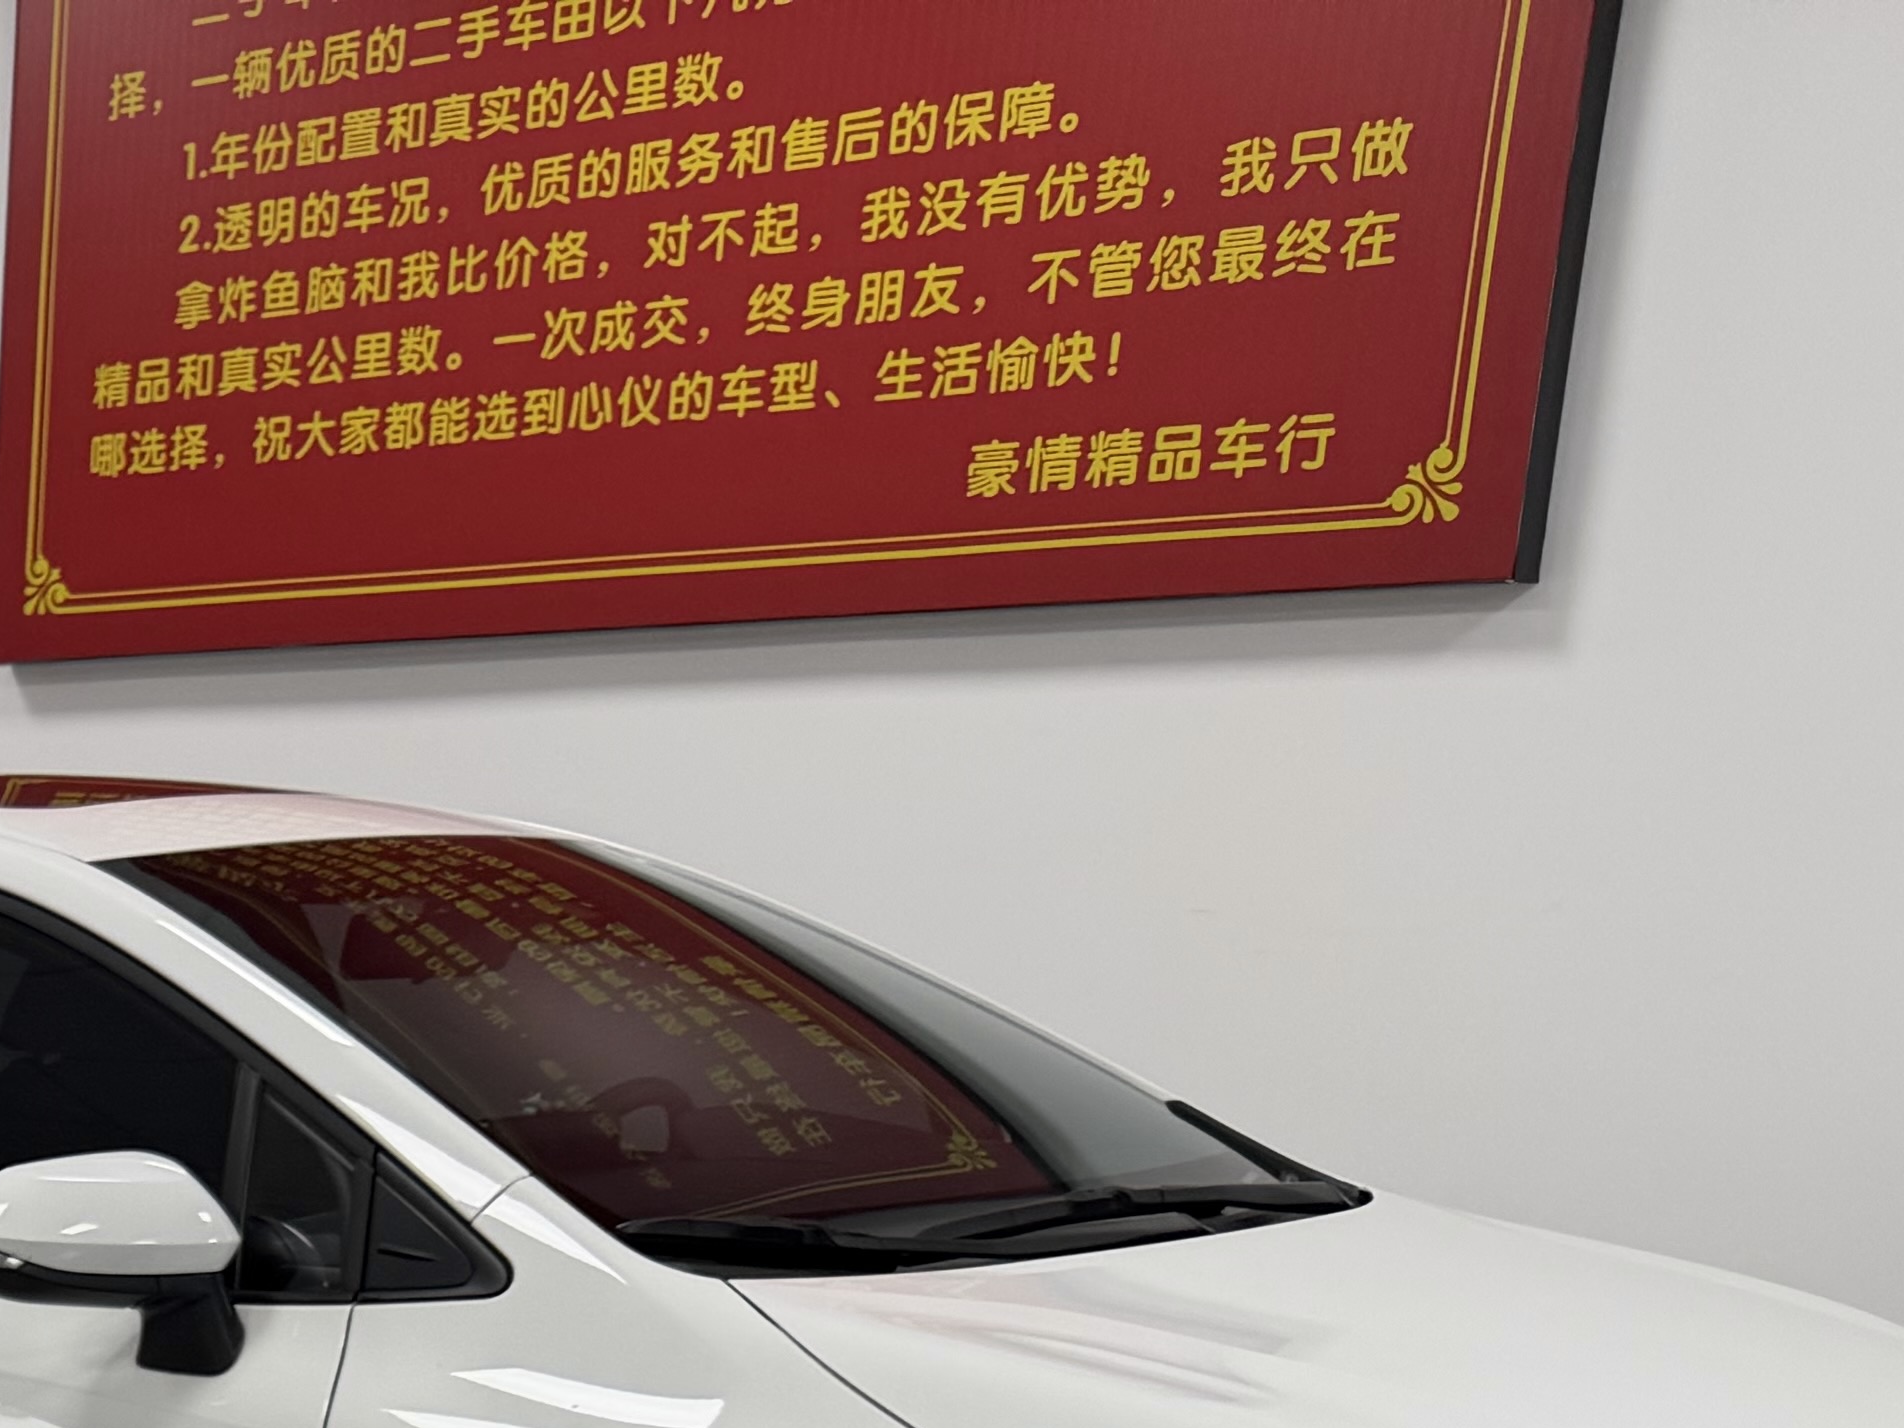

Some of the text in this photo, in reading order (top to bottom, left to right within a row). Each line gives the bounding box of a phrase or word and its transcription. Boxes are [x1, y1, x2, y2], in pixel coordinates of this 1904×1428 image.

[182, 50, 745, 181] 1.年份配置和真实的公里数。
[965, 412, 1336, 498] 豪情精品车行
